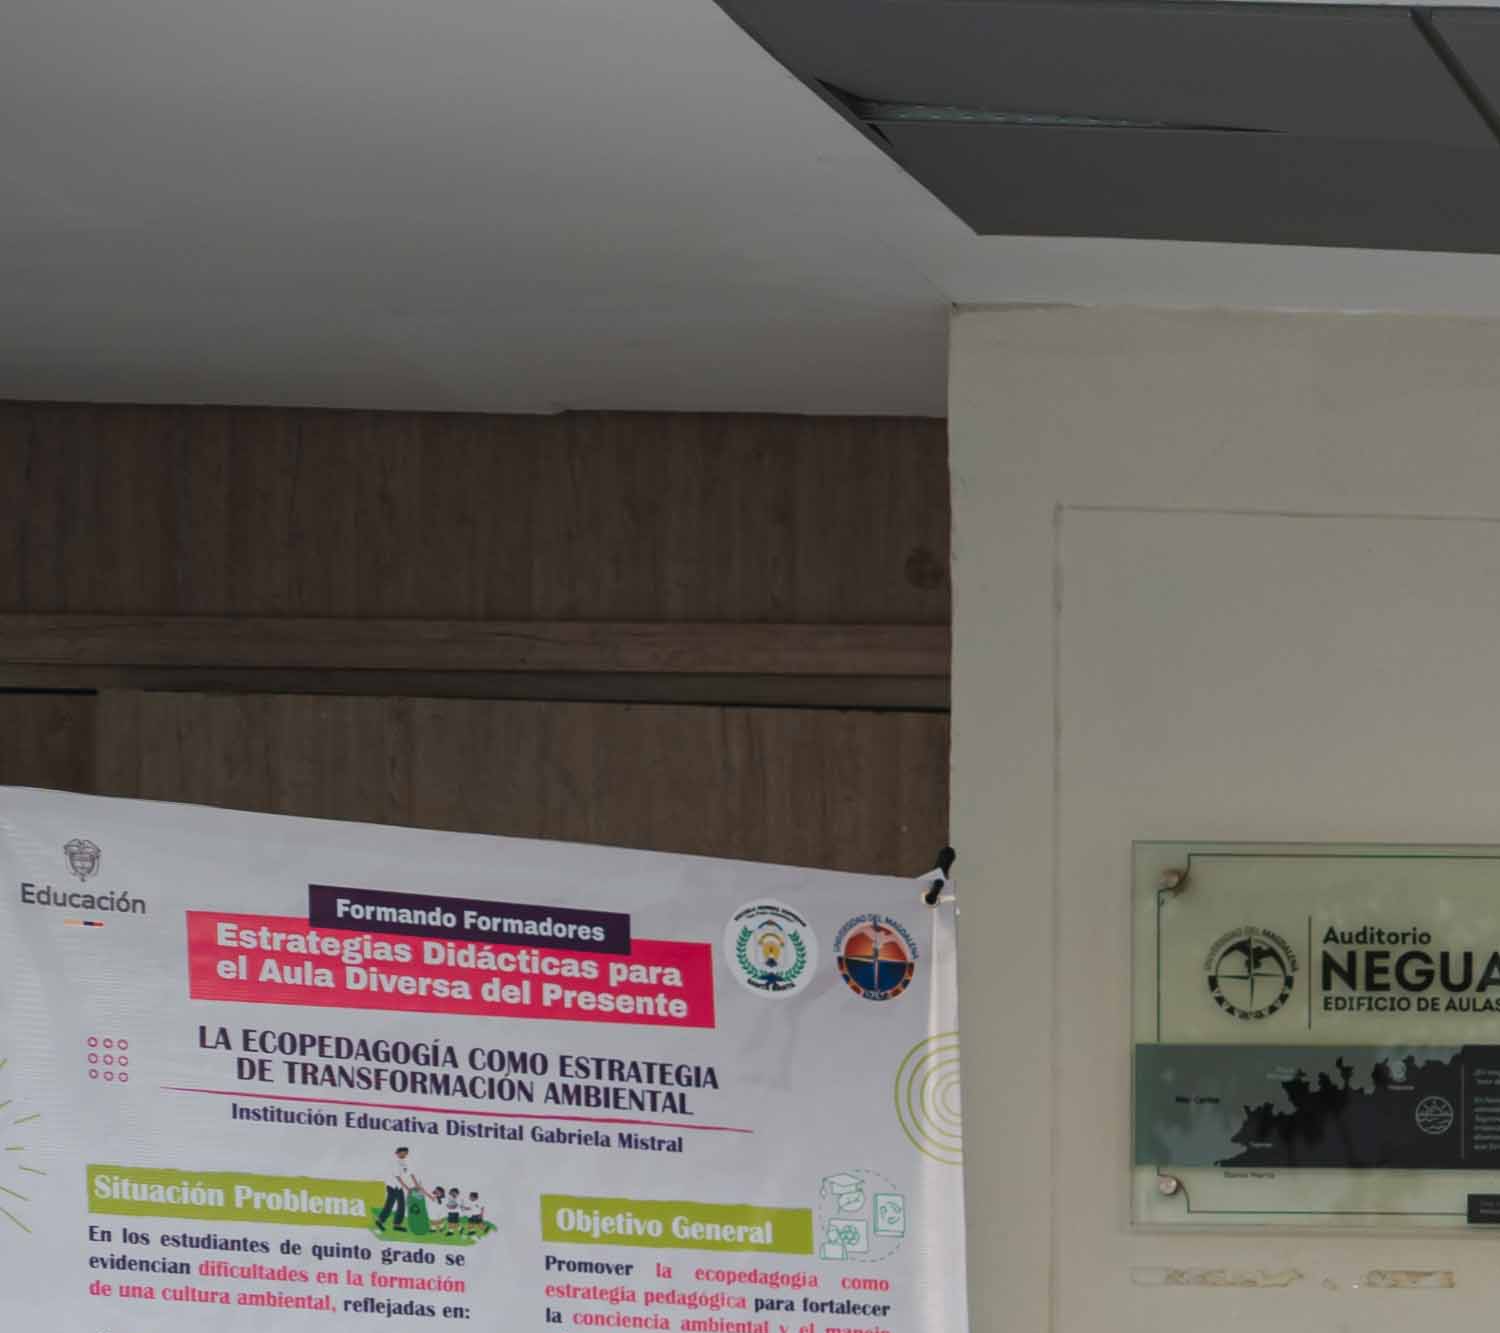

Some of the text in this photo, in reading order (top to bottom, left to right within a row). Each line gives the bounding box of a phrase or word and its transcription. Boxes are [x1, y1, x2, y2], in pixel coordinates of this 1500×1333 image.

[20, 882, 146, 914] Educación
[336, 898, 605, 941] Formando Formadores
[1323, 926, 1431, 945] Auditorio
[216, 921, 683, 987] Estrategias Didácticas para
[216, 956, 687, 1018] el Aula Diversa del Presente
[1323, 996, 1411, 1012] EDIFICIO
[1417, 997, 1440, 1012] DE
[199, 1025, 719, 1090] LA ECOPEDAGOGÍA COMO ESTRATEGIA
[237, 1057, 694, 1115] DE TRANSFORMACIÓN AMBIENTAL
[232, 1102, 683, 1153] Institución Educativa Distrital Gabriela Mistral
[94, 1174, 366, 1217] Situación Problema
[88, 1225, 465, 1267] En los estudiantes de quinto grado se
[555, 1207, 773, 1245] Objetivo General
[88, 1253, 465, 1293] evidencian dificultades en la formación
[88, 1279, 112, 1297] de
[119, 1285, 155, 1300] una
[161, 1285, 231, 1305] cultura
[343, 1296, 436, 1318] reflejadas
[442, 1305, 470, 1319] en:
